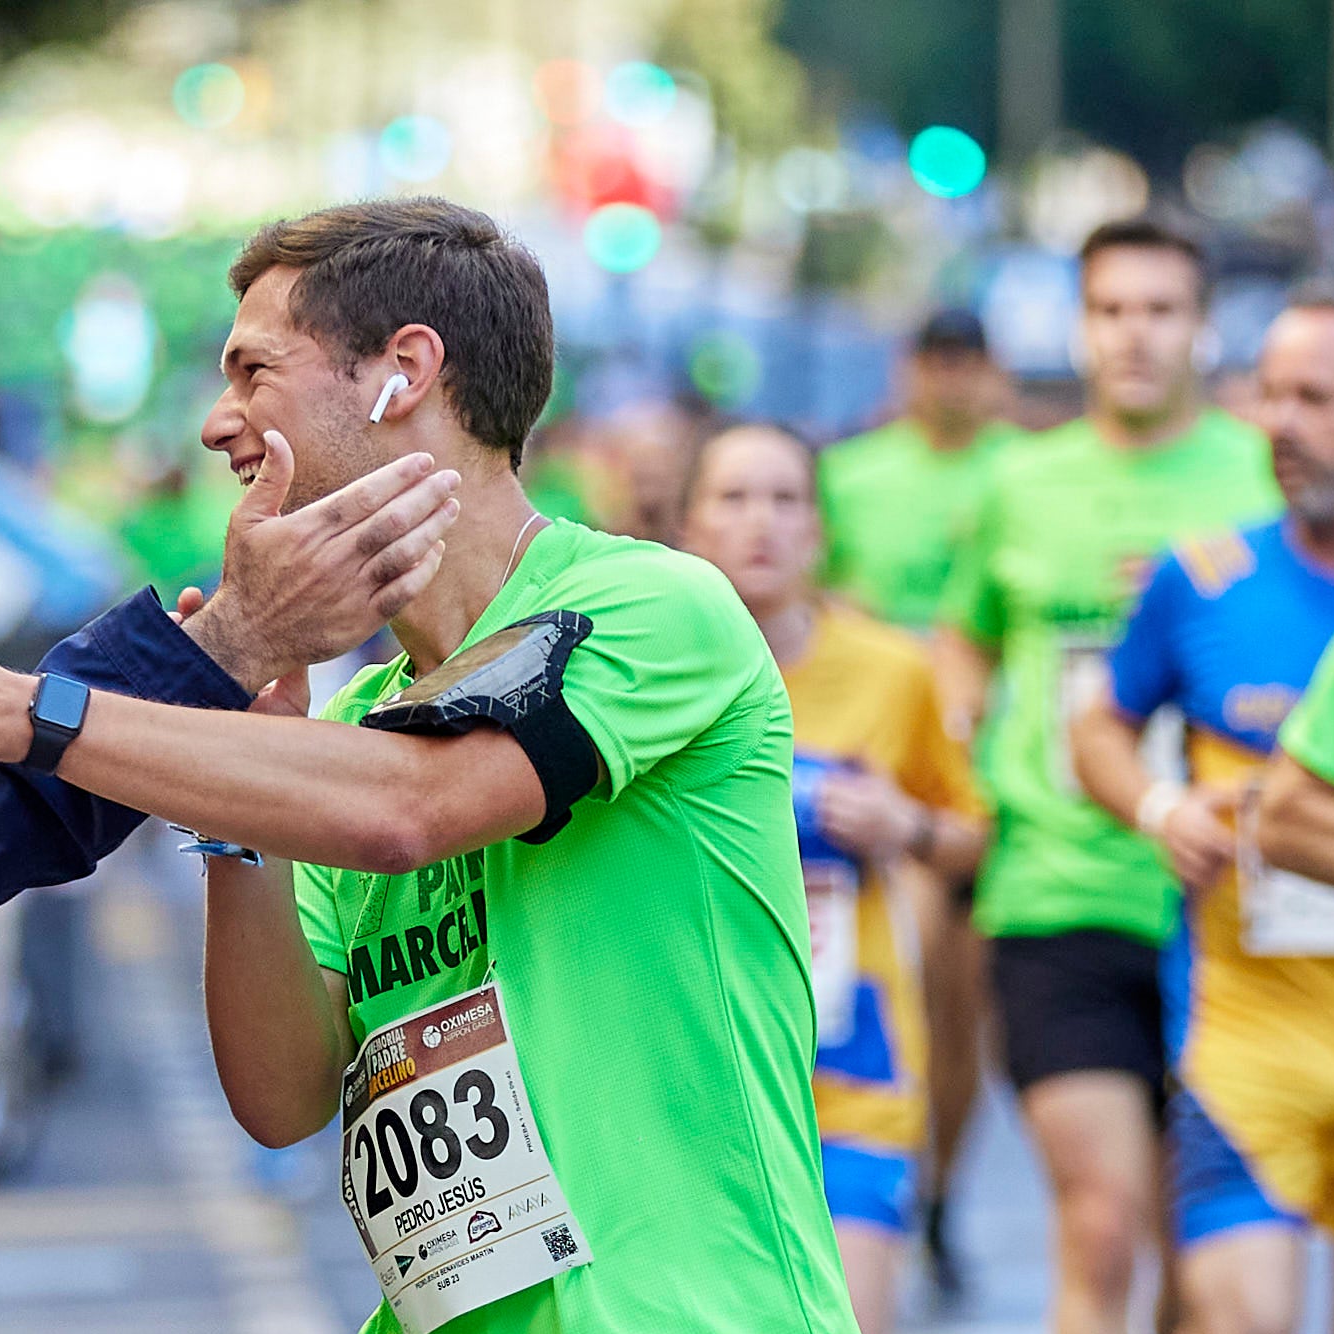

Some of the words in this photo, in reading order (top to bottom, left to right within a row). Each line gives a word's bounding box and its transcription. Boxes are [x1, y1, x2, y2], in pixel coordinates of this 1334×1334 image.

[440, 1003, 494, 1032] OXIMESA
[443, 1024, 471, 1043] NIPPON
[471, 1014, 496, 1033] GASES
[371, 1041, 407, 1074] PADRE
[354, 1069, 510, 1219] 2083
[394, 1199, 435, 1238] PEDRO
[437, 1176, 486, 1215] JESÚS
[508, 1192, 552, 1221] ANAYA
[426, 1229, 458, 1250] OXIMESA
[437, 1278, 451, 1291] SUB
[451, 1273, 461, 1283] 23
